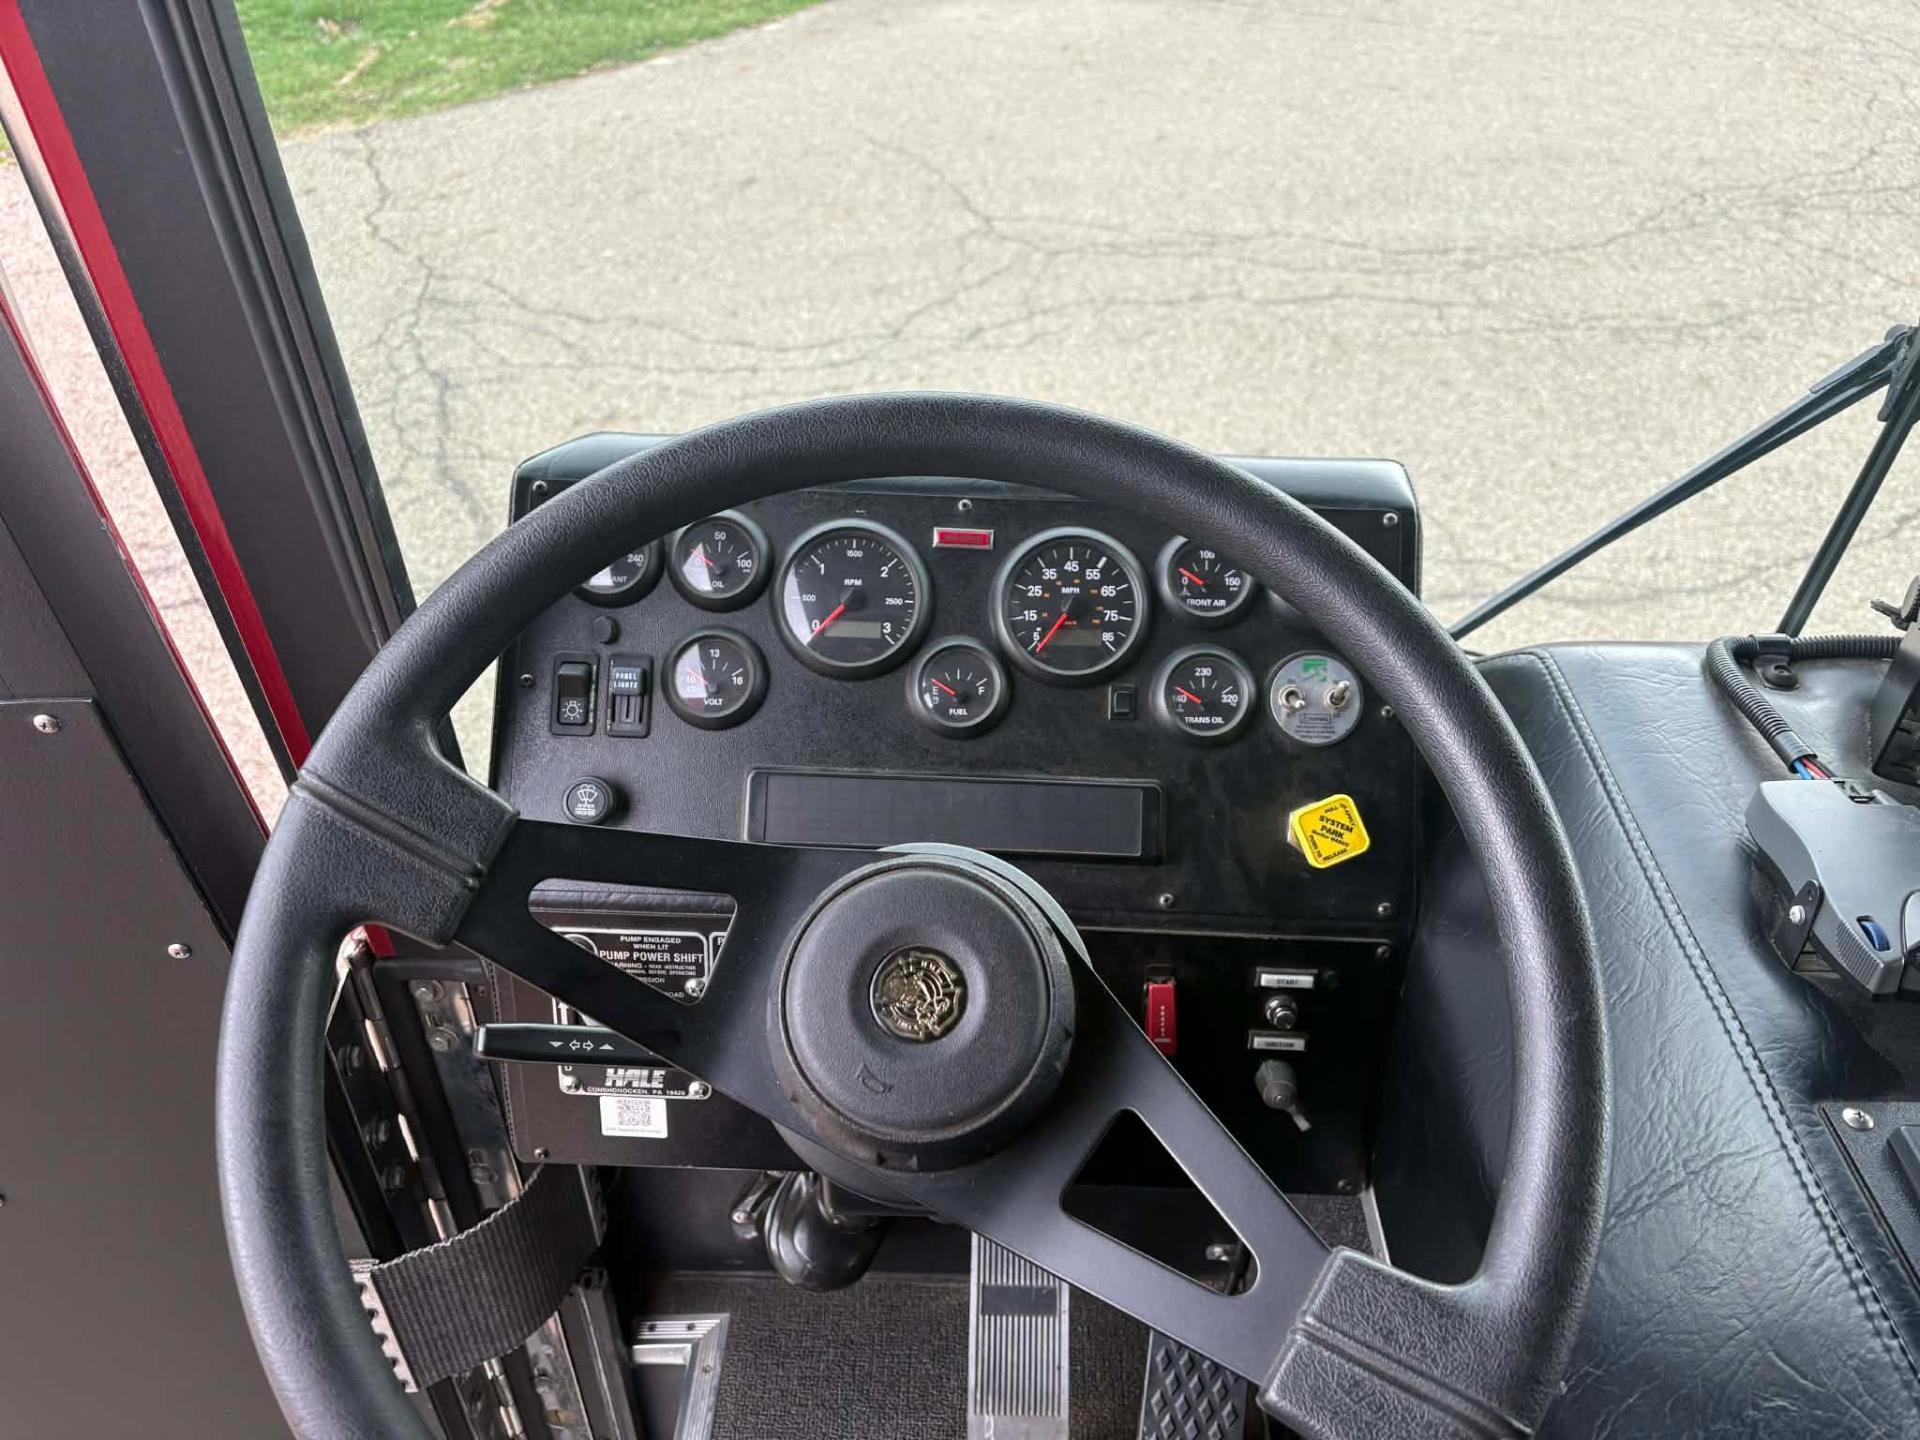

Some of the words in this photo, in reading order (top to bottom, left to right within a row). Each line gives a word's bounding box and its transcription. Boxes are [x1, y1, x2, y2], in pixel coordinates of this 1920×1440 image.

[714, 531, 726, 540] 50
[627, 553, 643, 563] 240
[846, 550, 863, 558] 1500
[1200, 550, 1215, 559] 100
[736, 559, 752, 568] 100
[1063, 561, 1079, 572] 45
[818, 563, 825, 575] 1
[880, 566, 889, 577] 2
[1042, 569, 1057, 580] 35
[1085, 569, 1101, 580] 55
[712, 580, 725, 588] OIL
[1182, 576, 1188, 585] 0
[1224, 577, 1240, 587] 150
[1027, 585, 1042, 597] 25
[1061, 586, 1080, 594] MPH
[1100, 585, 1116, 597] 65
[885, 598, 903, 606] 2500
[1186, 598, 1211, 606] FRONT
[1213, 599, 1227, 607] AIR
[1023, 610, 1037, 621] 15
[1103, 610, 1118, 621] 75
[811, 619, 820, 630] 0
[883, 622, 891, 633] 3
[1033, 633, 1040, 641] 5
[1101, 632, 1115, 641] 85
[709, 648, 720, 658] 13
[614, 672, 637, 680] PANEL
[1194, 667, 1212, 676] 230
[613, 681, 639, 689] LIGHTS
[731, 676, 743, 685] 16
[932, 686, 939, 695] E
[978, 686, 985, 695] F
[704, 698, 723, 706] VOLT
[1221, 694, 1238, 703] 320
[1185, 716, 1210, 724] TRANS
[1319, 815, 1353, 833] SYSTEM
[1320, 825, 1344, 839] PARK
[620, 935, 642, 943] PUMP
[643, 936, 682, 944] ENGAGED
[599, 950, 630, 960] PUMP
[632, 952, 671, 962] POWER
[673, 953, 704, 962] SHIFT
[604, 1067, 666, 1088] HALE
